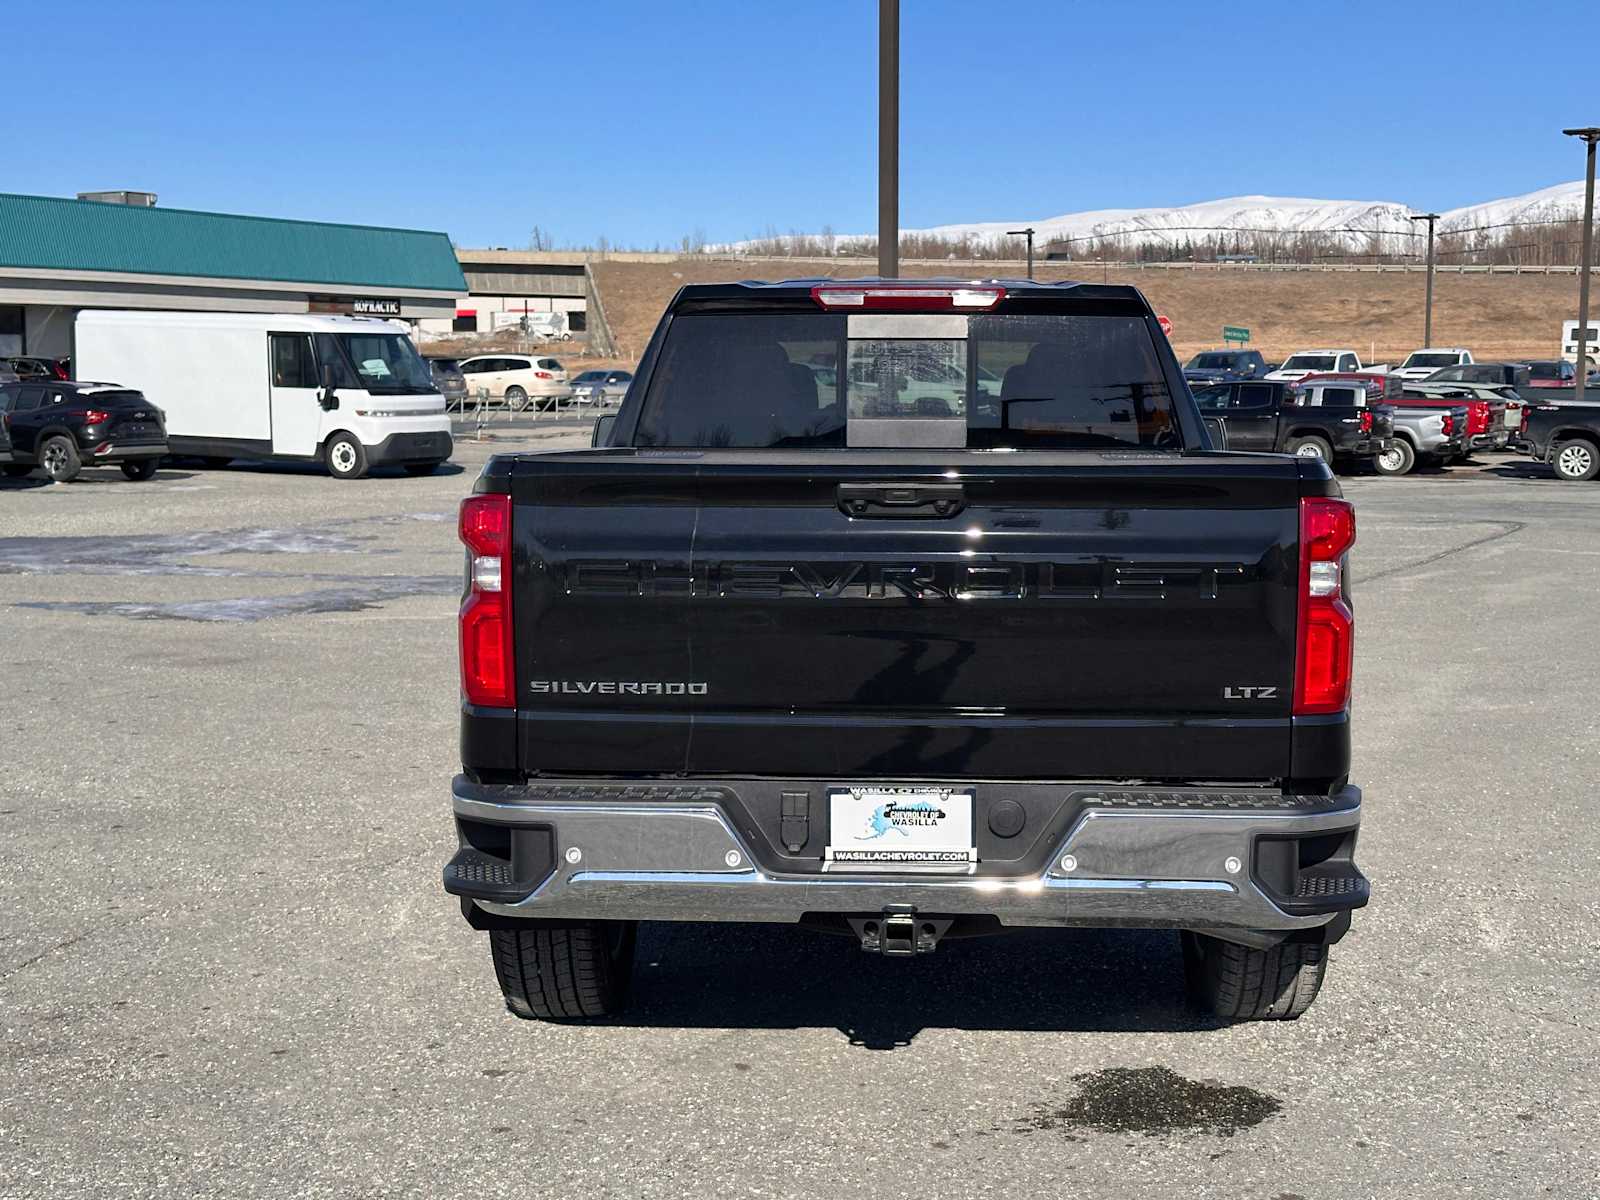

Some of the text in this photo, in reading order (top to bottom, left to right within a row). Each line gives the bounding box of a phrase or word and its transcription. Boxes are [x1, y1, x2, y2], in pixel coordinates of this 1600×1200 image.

[565, 559, 1244, 600] CHEVROLET
[530, 681, 708, 695] SILVERADO
[1224, 687, 1277, 699] LTZ
[890, 811, 940, 819] CHEVROLET OF
[891, 818, 938, 826] WASILLA
[835, 851, 967, 861] WASILLACHEVROLET.COM
